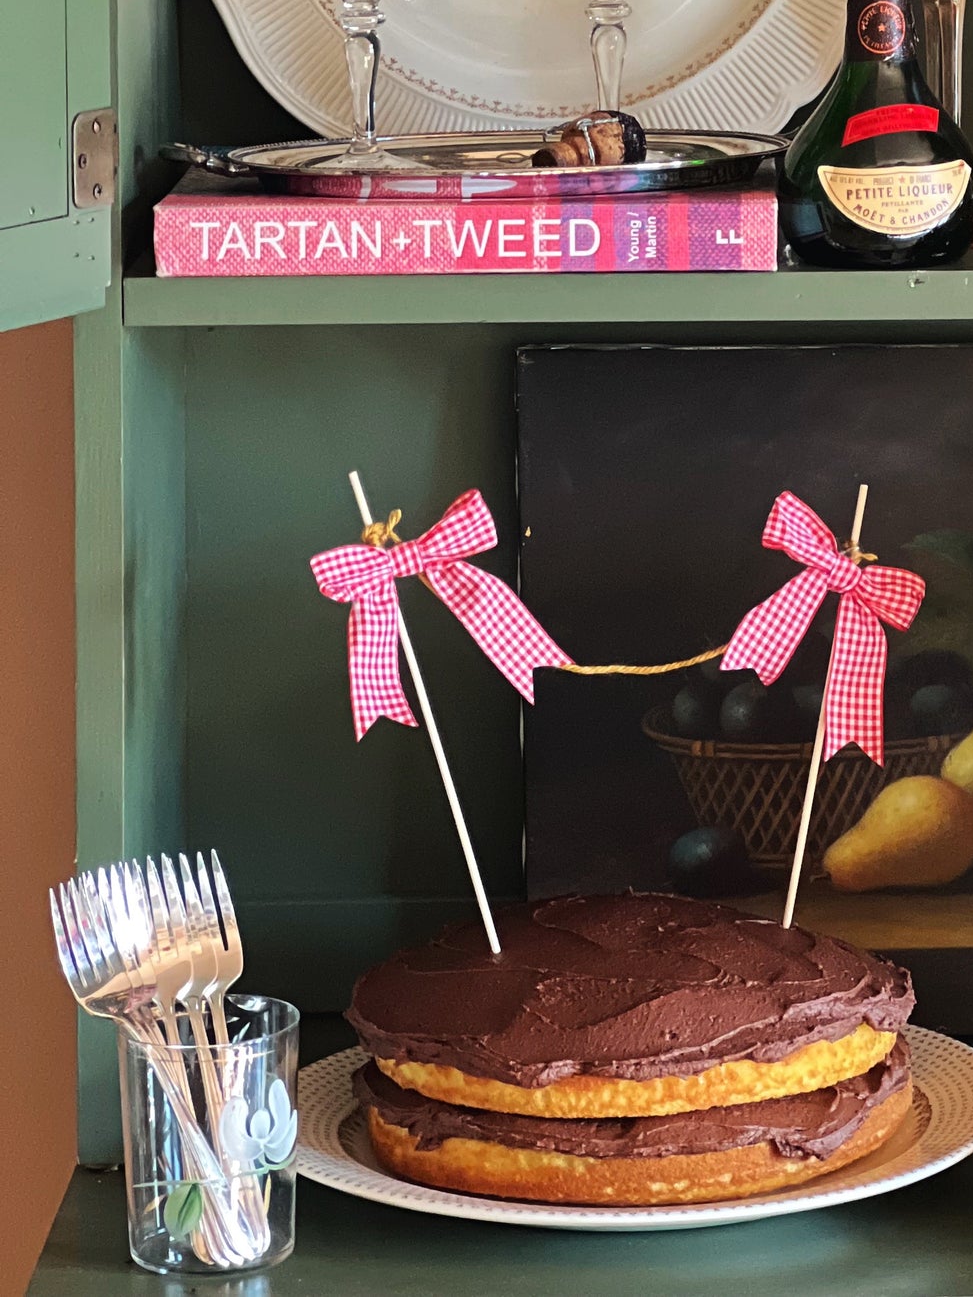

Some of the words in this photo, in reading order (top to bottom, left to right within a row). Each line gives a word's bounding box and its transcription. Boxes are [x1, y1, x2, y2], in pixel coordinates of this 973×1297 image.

[846, 186, 893, 200] PETITE
[899, 183, 954, 197] LIQUEUR
[889, 217, 896, 225] &
[902, 199, 950, 225] CHANDON
[628, 219, 642, 262] Young
[645, 216, 657, 258] Martin
